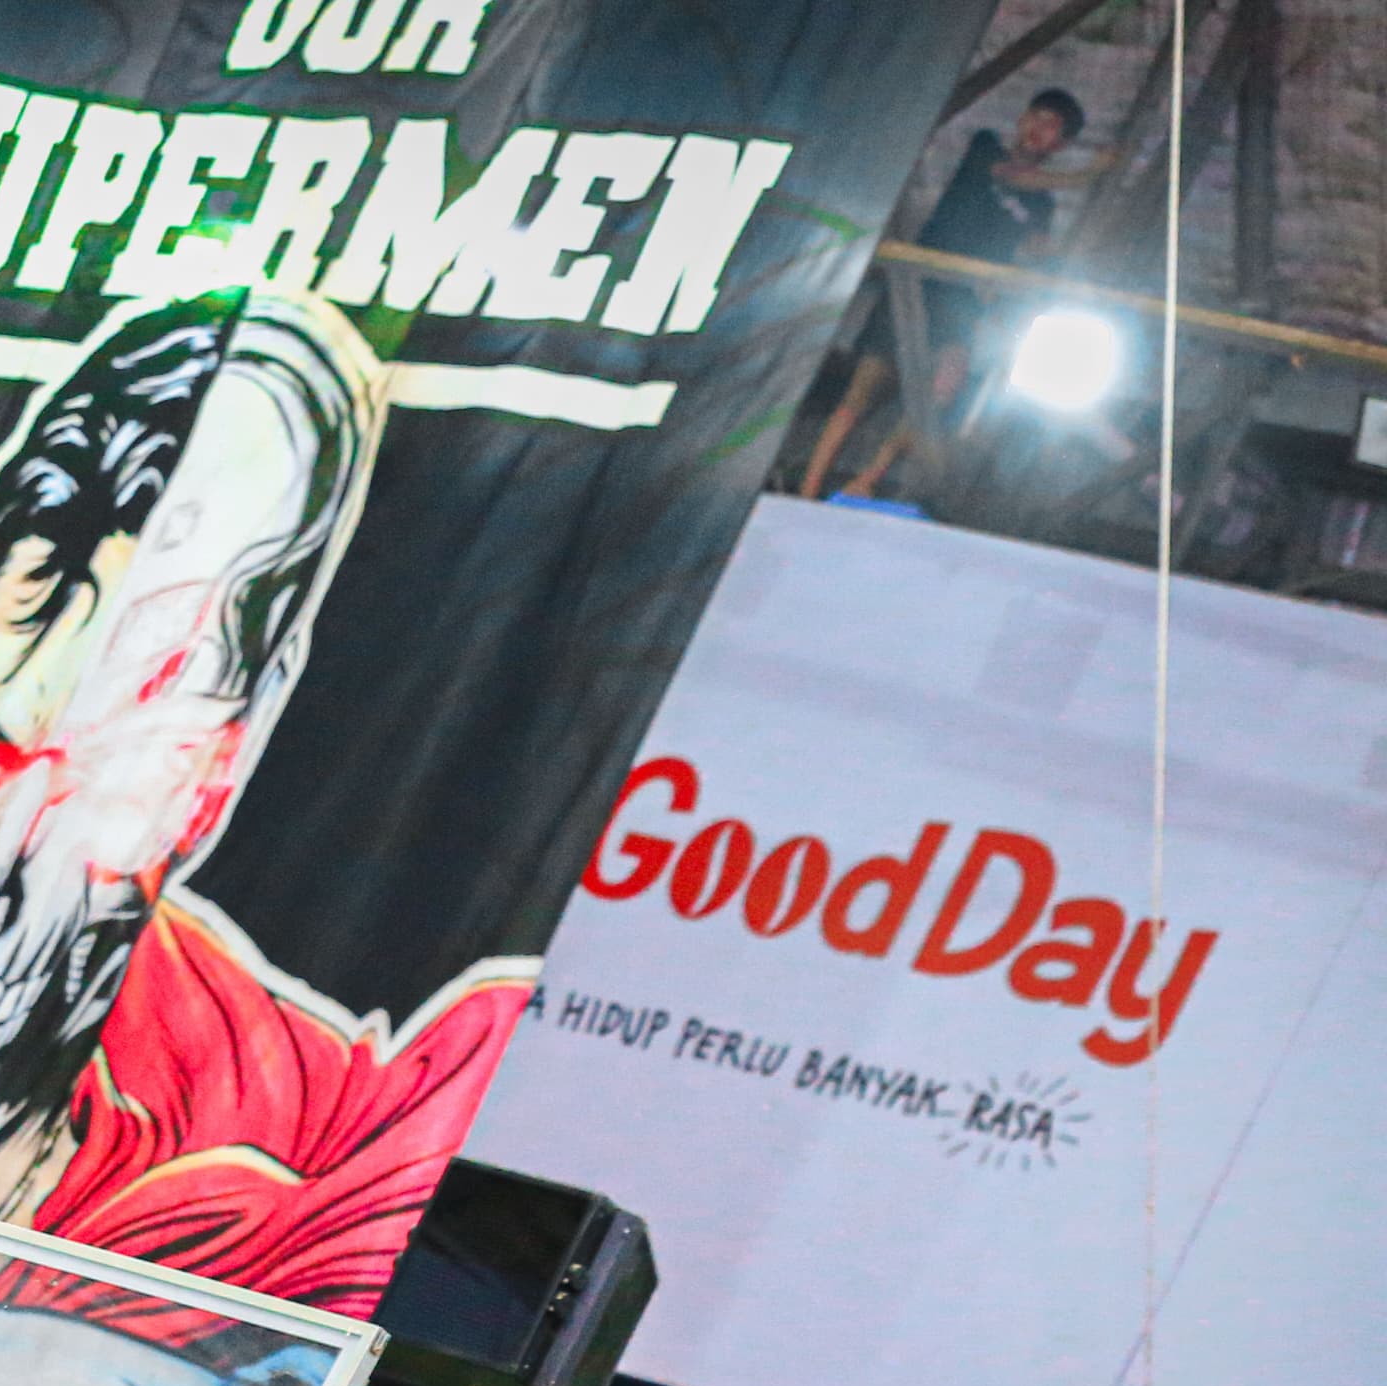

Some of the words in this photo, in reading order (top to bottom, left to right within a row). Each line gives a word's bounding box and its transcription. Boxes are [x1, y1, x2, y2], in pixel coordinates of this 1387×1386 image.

[556, 989, 670, 1050] HIDUP
[673, 1016, 791, 1078] PERLU
[794, 1049, 949, 1117] BANYAK
[964, 1093, 1056, 1149] RASA
